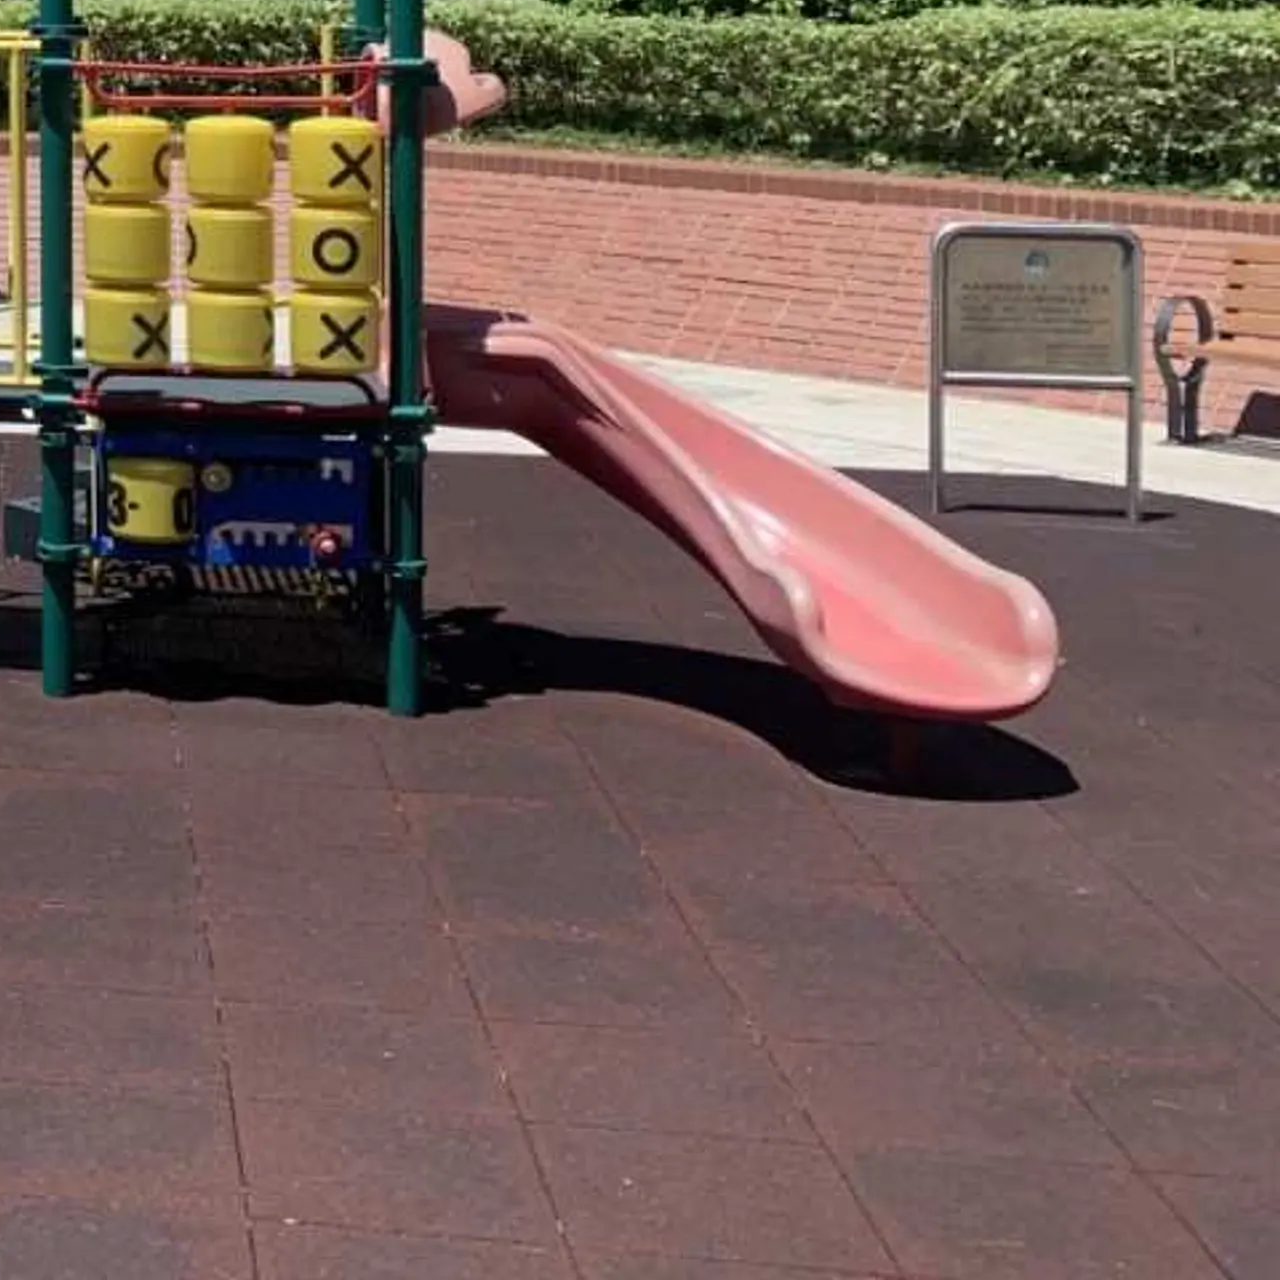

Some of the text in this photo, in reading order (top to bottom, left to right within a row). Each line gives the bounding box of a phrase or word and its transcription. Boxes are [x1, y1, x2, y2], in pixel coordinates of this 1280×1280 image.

[329, 141, 374, 191] X
[312, 228, 359, 275] O
[132, 312, 169, 360] X
[319, 312, 366, 362] X
